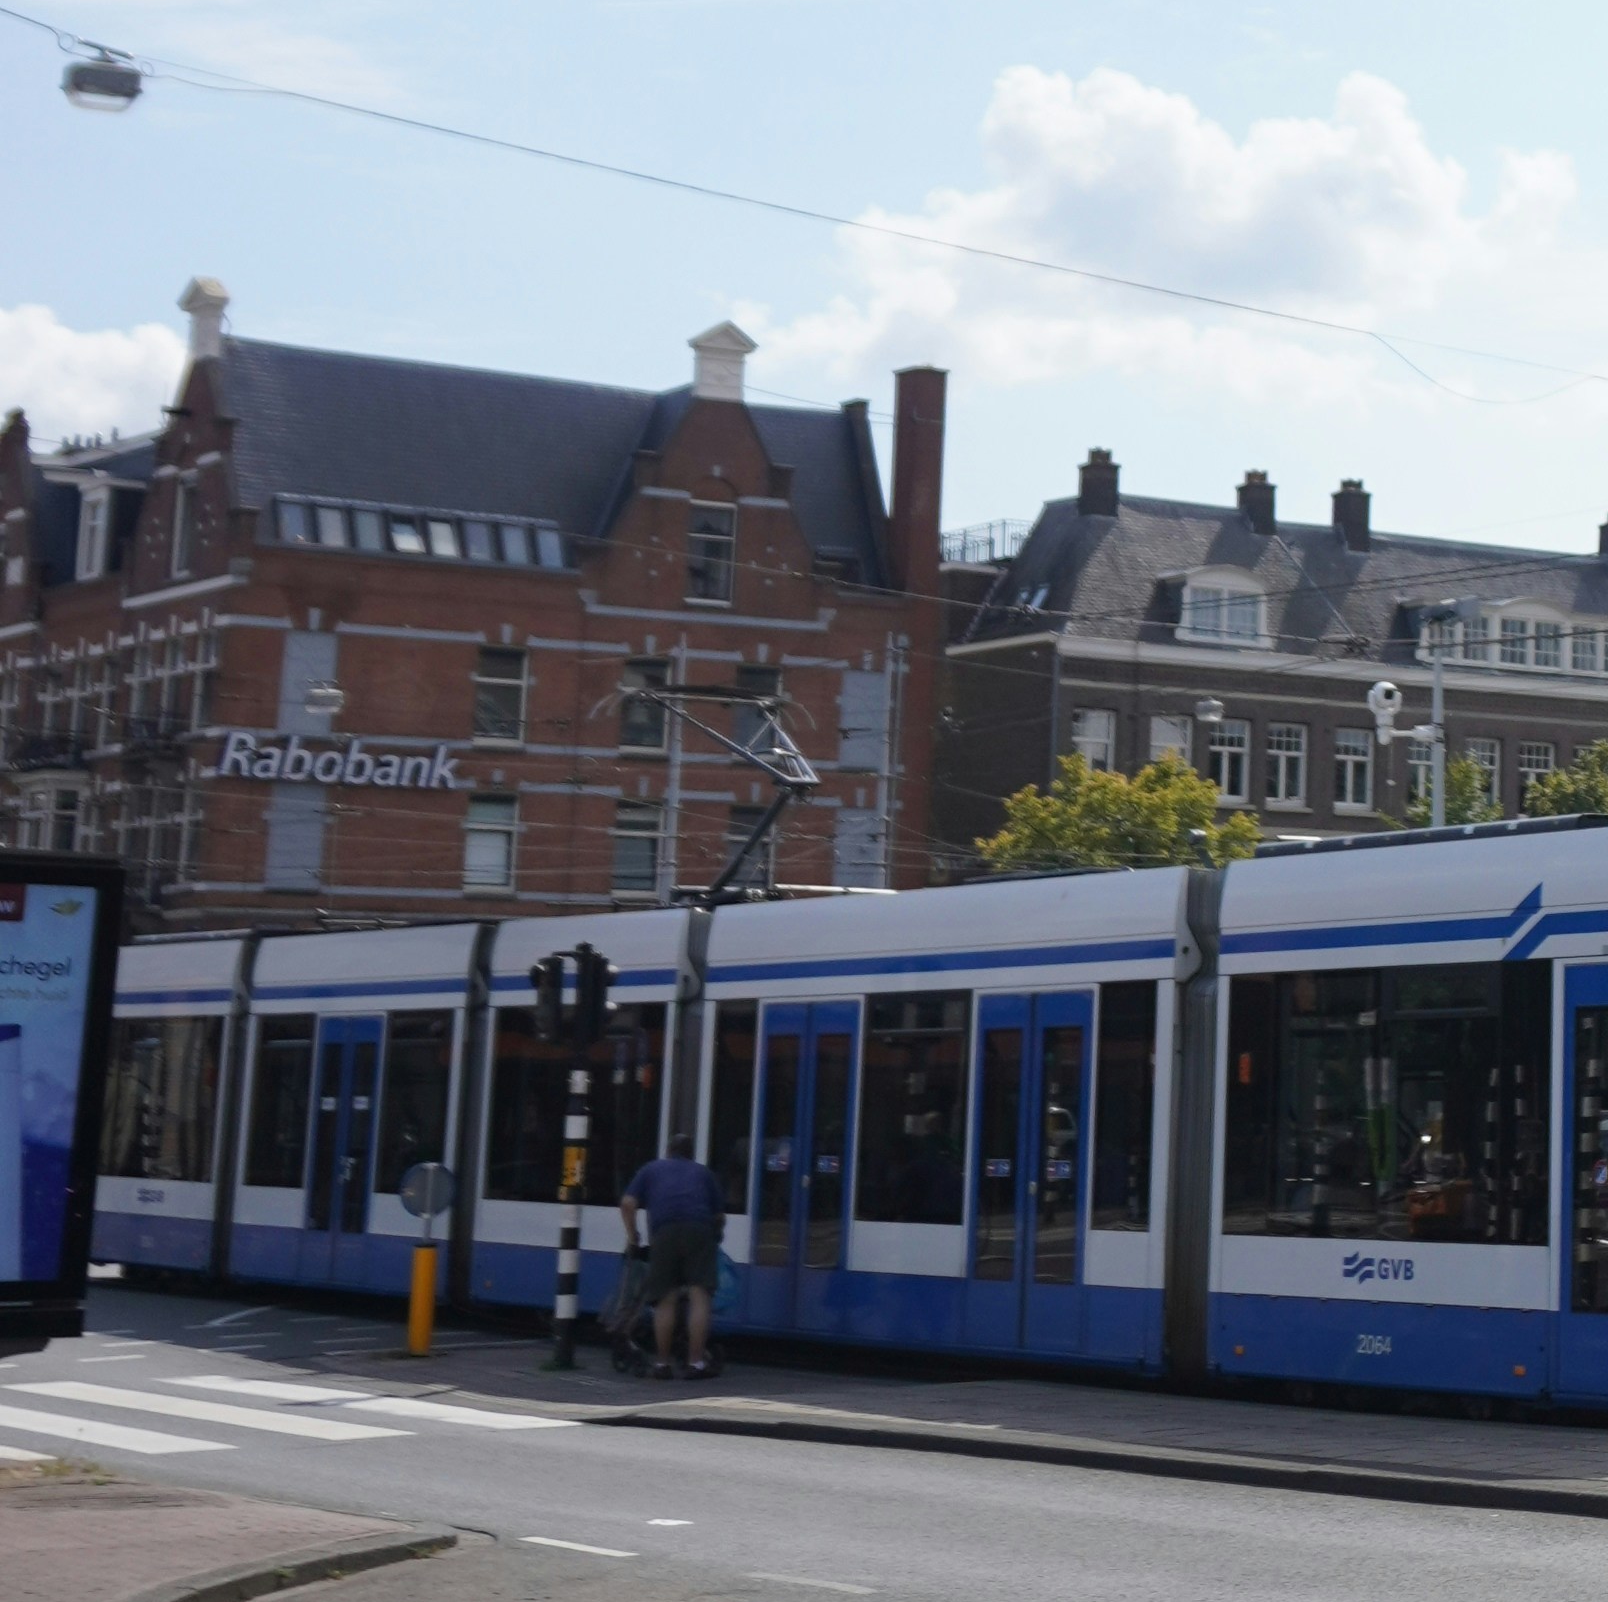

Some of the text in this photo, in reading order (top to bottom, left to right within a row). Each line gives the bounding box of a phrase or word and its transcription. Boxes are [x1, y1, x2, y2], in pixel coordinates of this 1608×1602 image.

[217, 731, 458, 789] Rabobank
[1378, 1258, 1415, 1281] GVB
[1357, 1334, 1392, 1355] 2064
